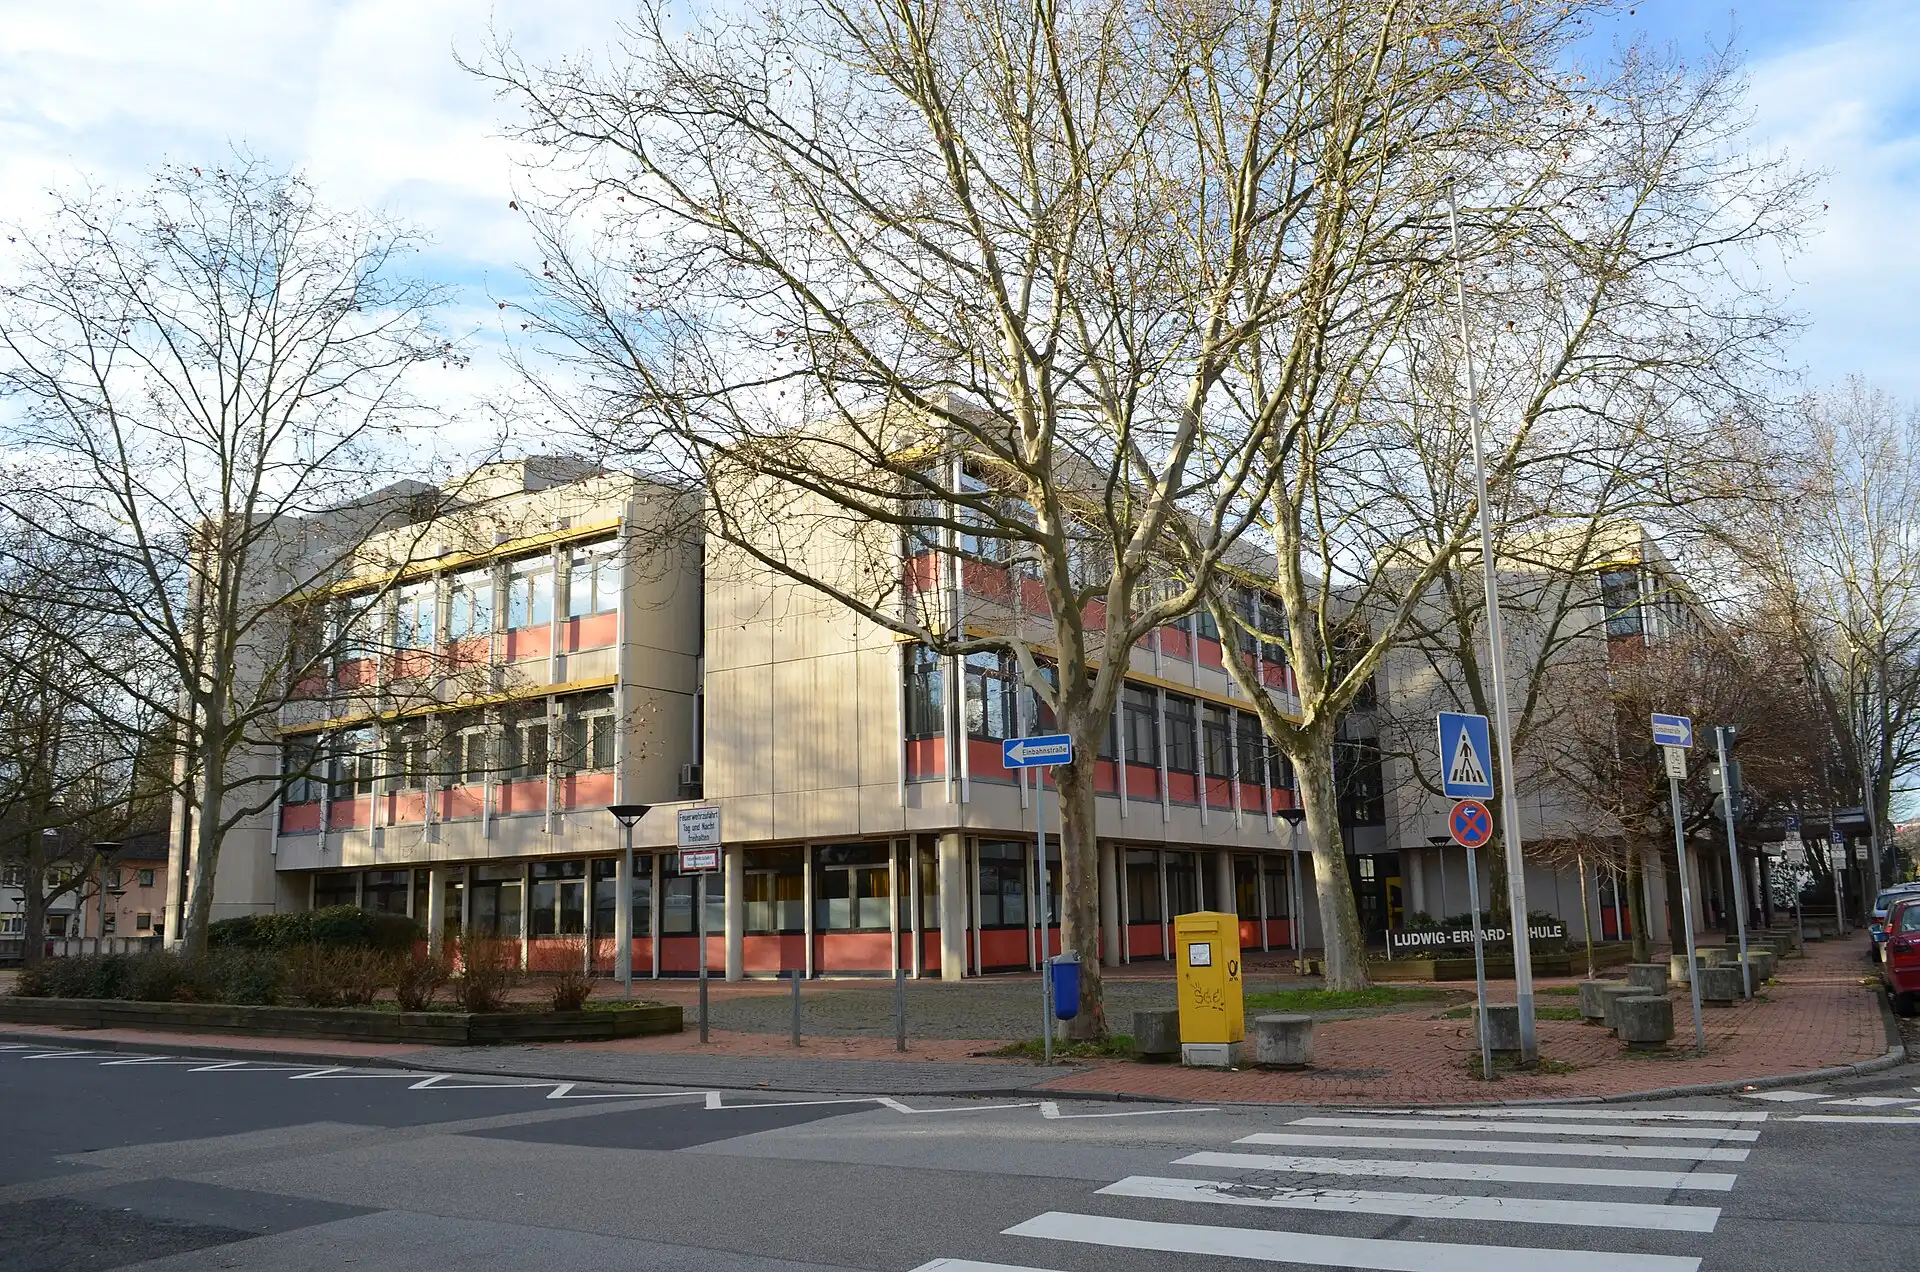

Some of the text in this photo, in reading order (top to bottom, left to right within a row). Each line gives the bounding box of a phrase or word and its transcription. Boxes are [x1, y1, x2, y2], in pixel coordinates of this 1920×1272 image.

[1023, 745, 1067, 756] Einbahnstraße
[680, 811, 718, 822] Feuerwehrzufahrt
[691, 823, 700, 831] und
[701, 822, 715, 831] Nacht
[1394, 925, 1562, 947] LUDWIG-ERHARD-HULE
